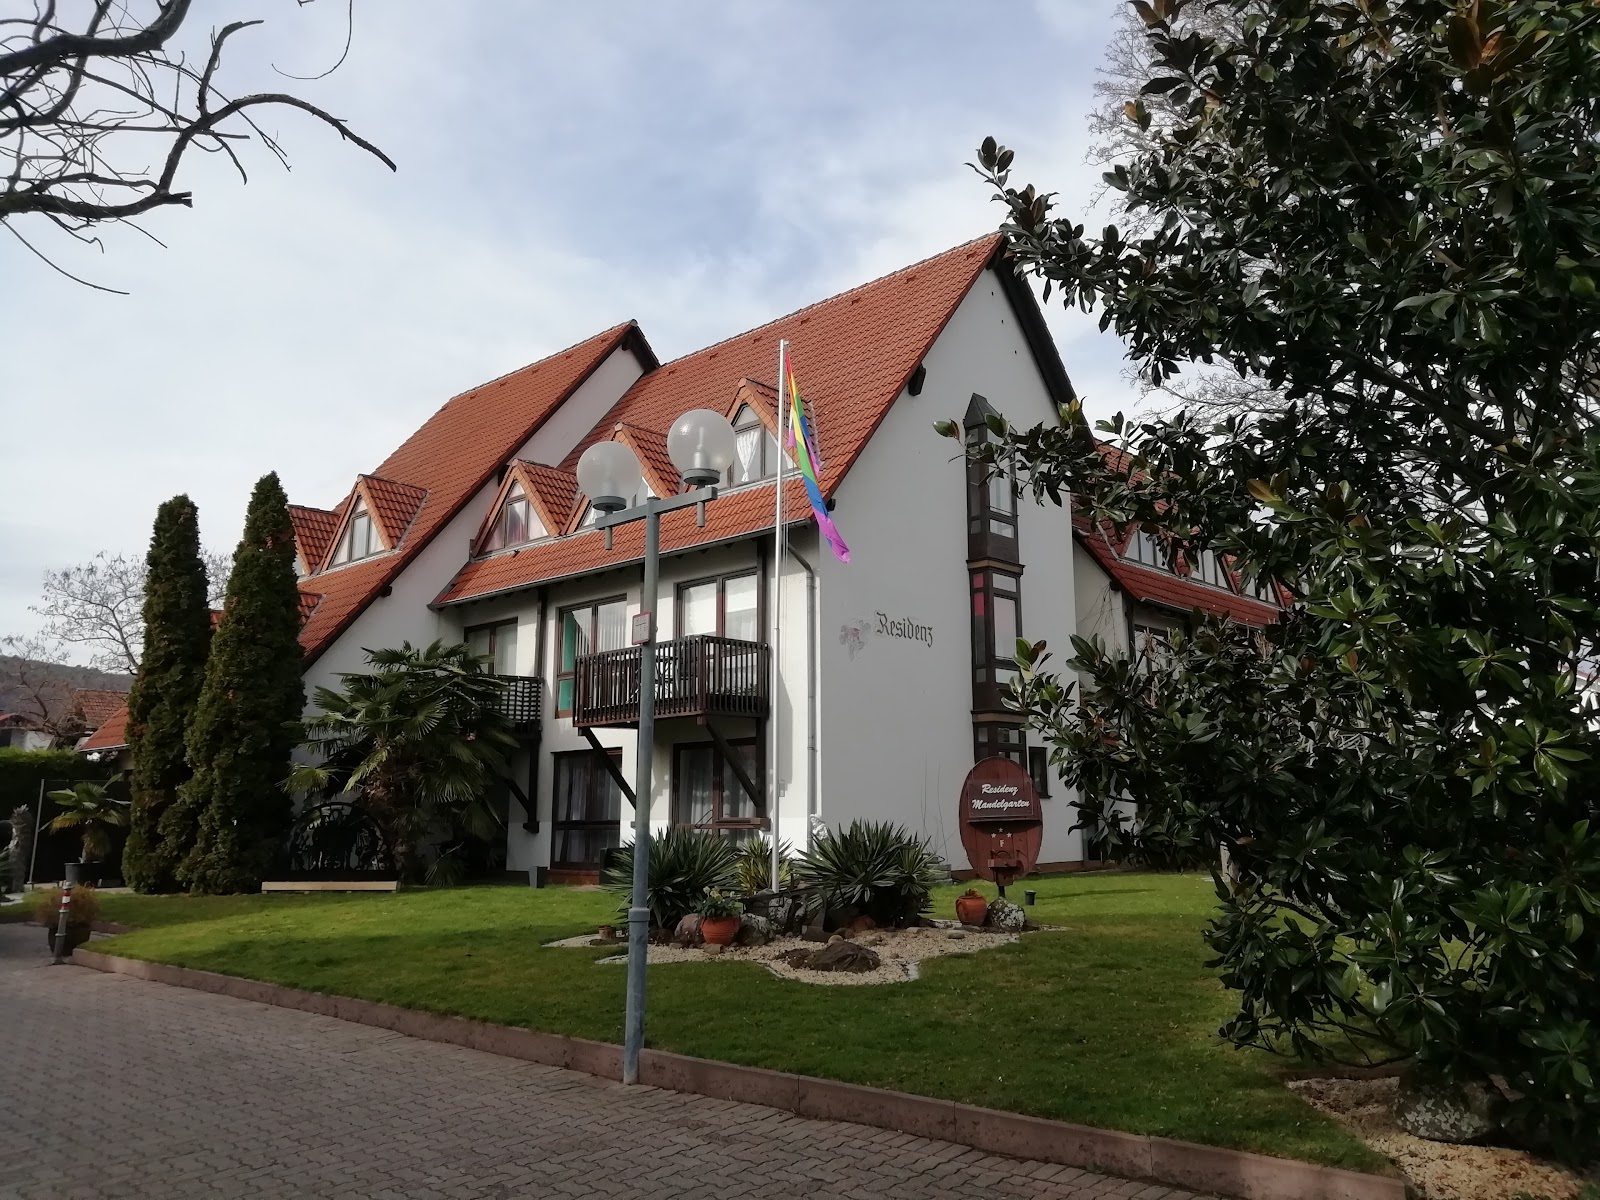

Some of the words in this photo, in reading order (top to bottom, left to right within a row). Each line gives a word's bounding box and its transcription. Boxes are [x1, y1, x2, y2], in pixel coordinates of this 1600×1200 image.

[876, 611, 933, 648] Residenz
[981, 783, 1018, 796] Residenz
[971, 799, 1030, 811] Mandelgarten
[999, 839, 1005, 848] F
